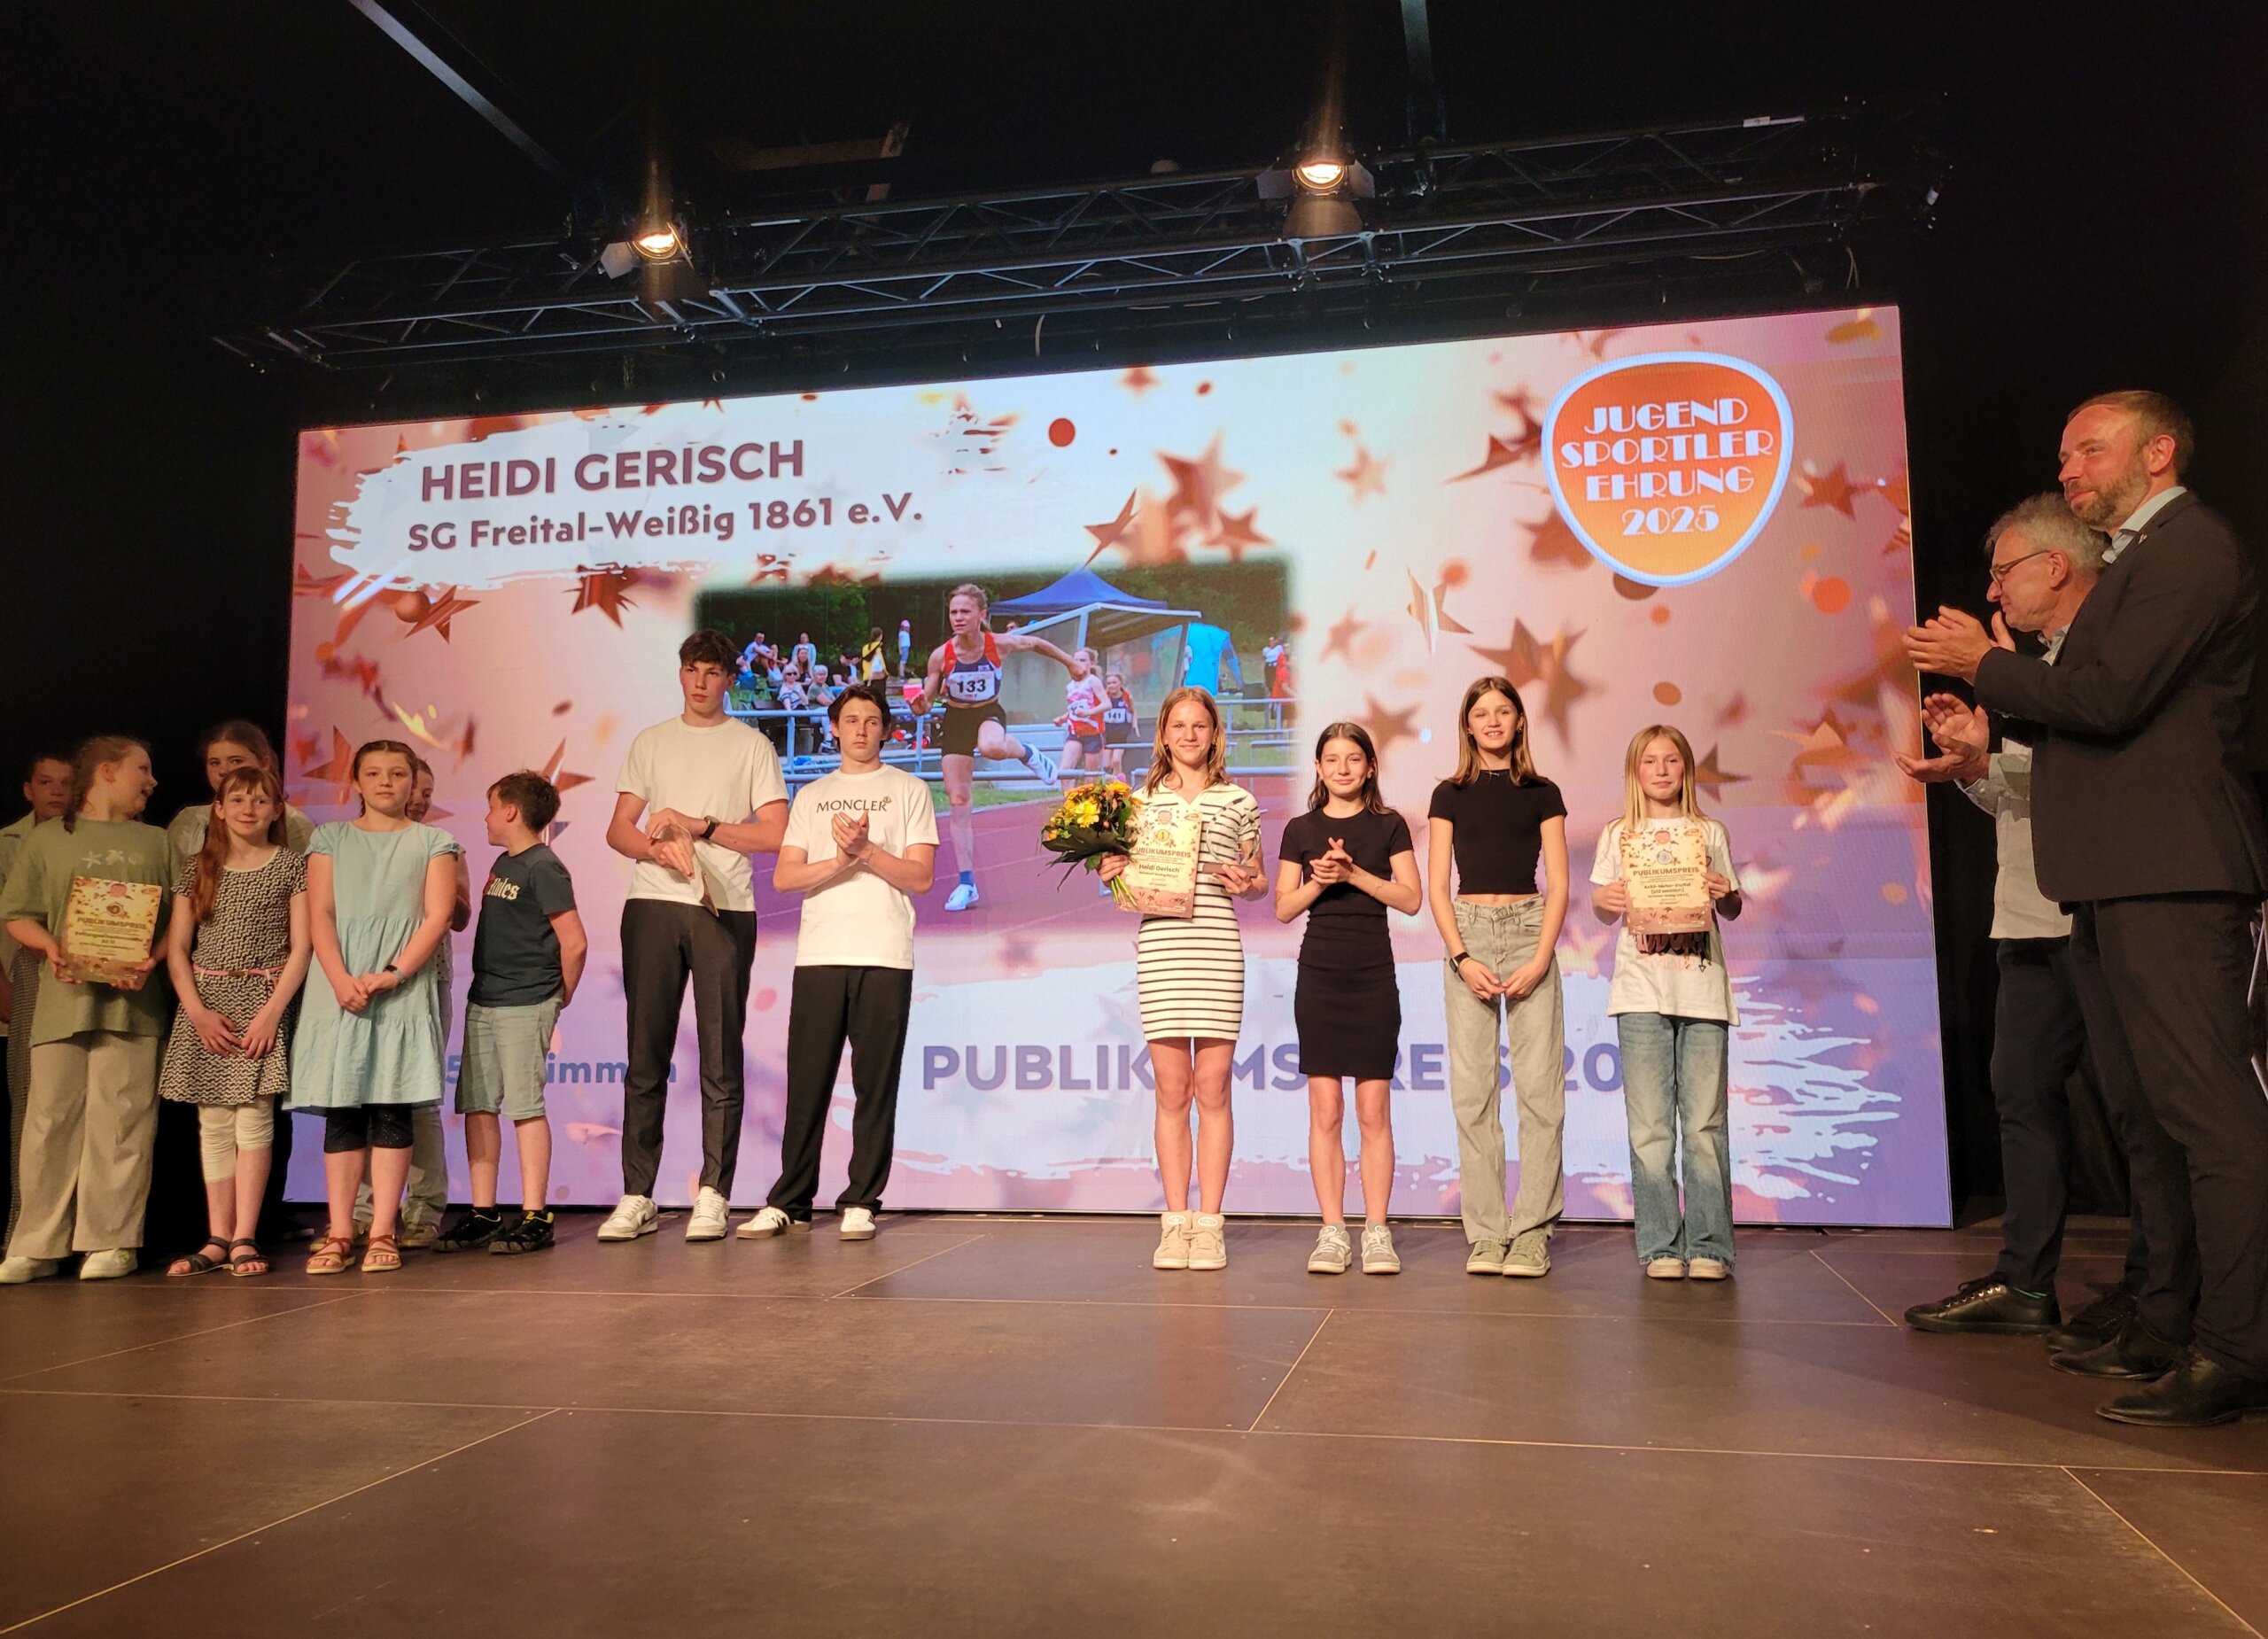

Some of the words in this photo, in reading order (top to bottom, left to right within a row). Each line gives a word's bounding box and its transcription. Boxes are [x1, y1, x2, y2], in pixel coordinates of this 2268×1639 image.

[1583, 398, 1748, 434] JUGEND
[1561, 429, 1774, 469] SPORTLER
[421, 457, 556, 501] HEIDI
[574, 439, 804, 491] GERISCH
[1586, 466, 1754, 502] EHRUNG
[408, 522, 457, 552] SG
[470, 503, 735, 548] Freital-Weißig
[749, 497, 833, 531] 1861
[848, 492, 923, 524] e.V.
[1621, 504, 1720, 536] 2025
[957, 679, 986, 693] 133
[816, 799, 888, 813] MONCLER
[1633, 866, 1699, 877] PUBLIKUMSPREIS
